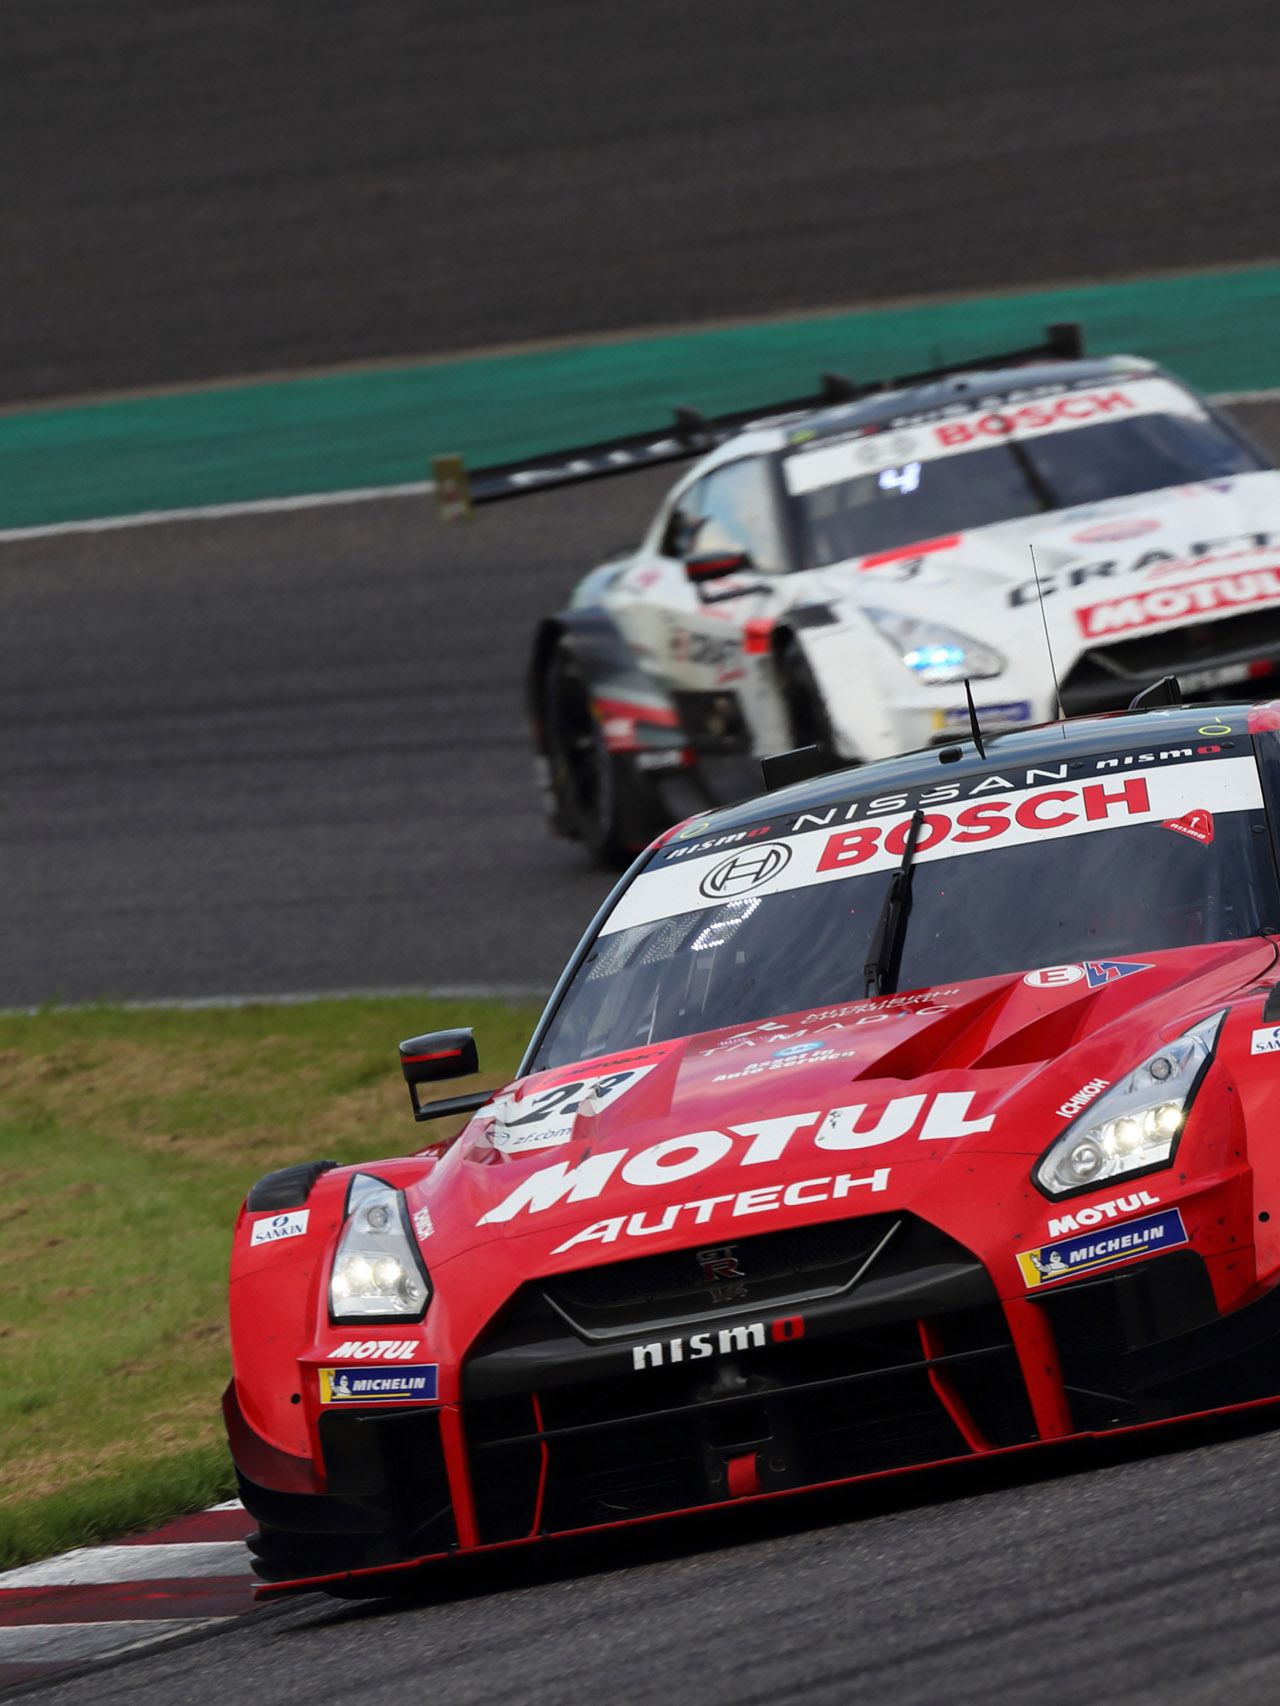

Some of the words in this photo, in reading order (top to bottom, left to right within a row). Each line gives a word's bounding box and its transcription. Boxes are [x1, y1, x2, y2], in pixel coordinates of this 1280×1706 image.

[935, 391, 1138, 447] BOSCH
[879, 460, 922, 495] 4
[1006, 530, 1280, 608] CRAFT
[1096, 744, 1222, 770] nismo
[790, 763, 1070, 832] NISSAN
[664, 826, 772, 861] nismo
[815, 777, 1152, 874] BOSCH
[1056, 1078, 1110, 1119] ICHIKOH
[512, 1126, 571, 1146] zf.com
[475, 1091, 996, 1227] MOTUL
[550, 1168, 892, 1255] AUTECH
[1048, 1190, 1160, 1237] MOTUL
[255, 1223, 304, 1242] SANKIN
[1069, 1225, 1164, 1264] MICHELIN
[326, 1341, 419, 1360] MOTUL
[634, 1315, 805, 1370] nismo
[352, 1377, 426, 1391] MICHELIN
